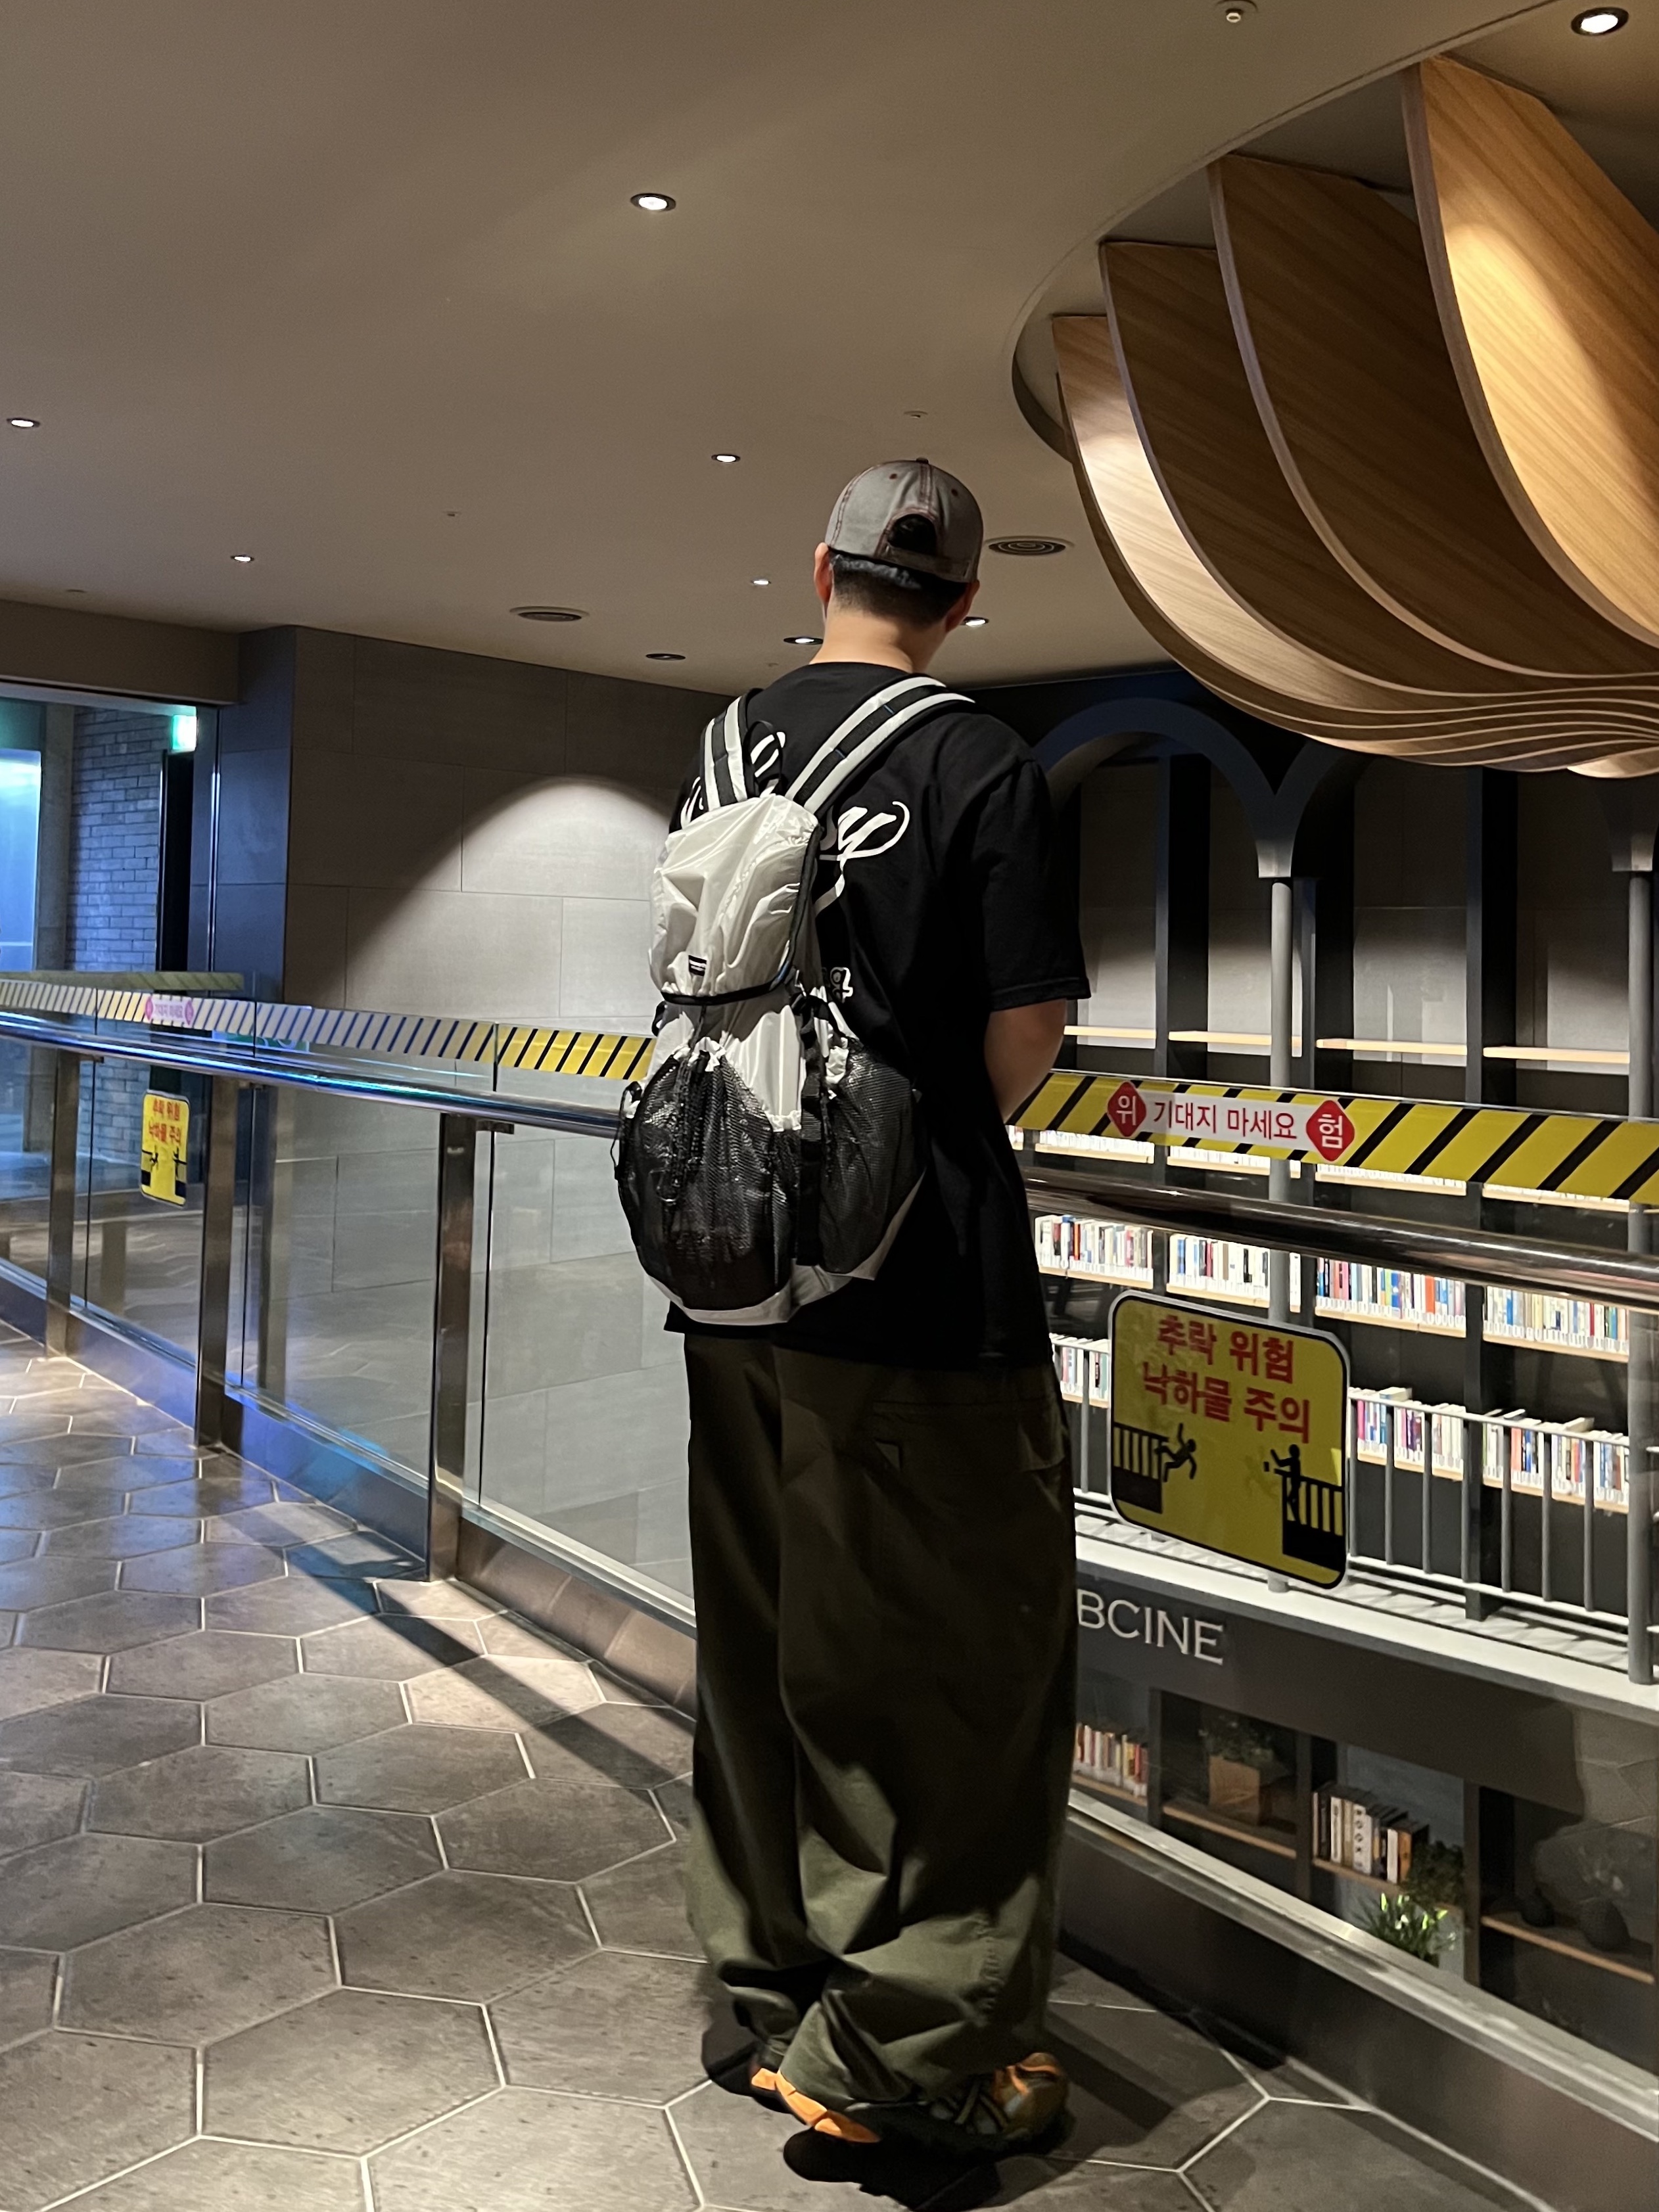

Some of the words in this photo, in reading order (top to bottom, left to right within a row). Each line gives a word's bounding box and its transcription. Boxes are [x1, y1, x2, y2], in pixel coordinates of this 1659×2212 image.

[1115, 1094, 1137, 1126] 위
[1153, 1100, 1217, 1134] 기대지
[1227, 1107, 1297, 1140] 마세요
[1318, 1115, 1344, 1149] 험
[1157, 1314, 1217, 1366] 추락
[1228, 1330, 1294, 1384] 위험
[1142, 1361, 1232, 1422] 낙하물
[1244, 1387, 1310, 1444] 주의
[1077, 1588, 1224, 1665] BCINE
